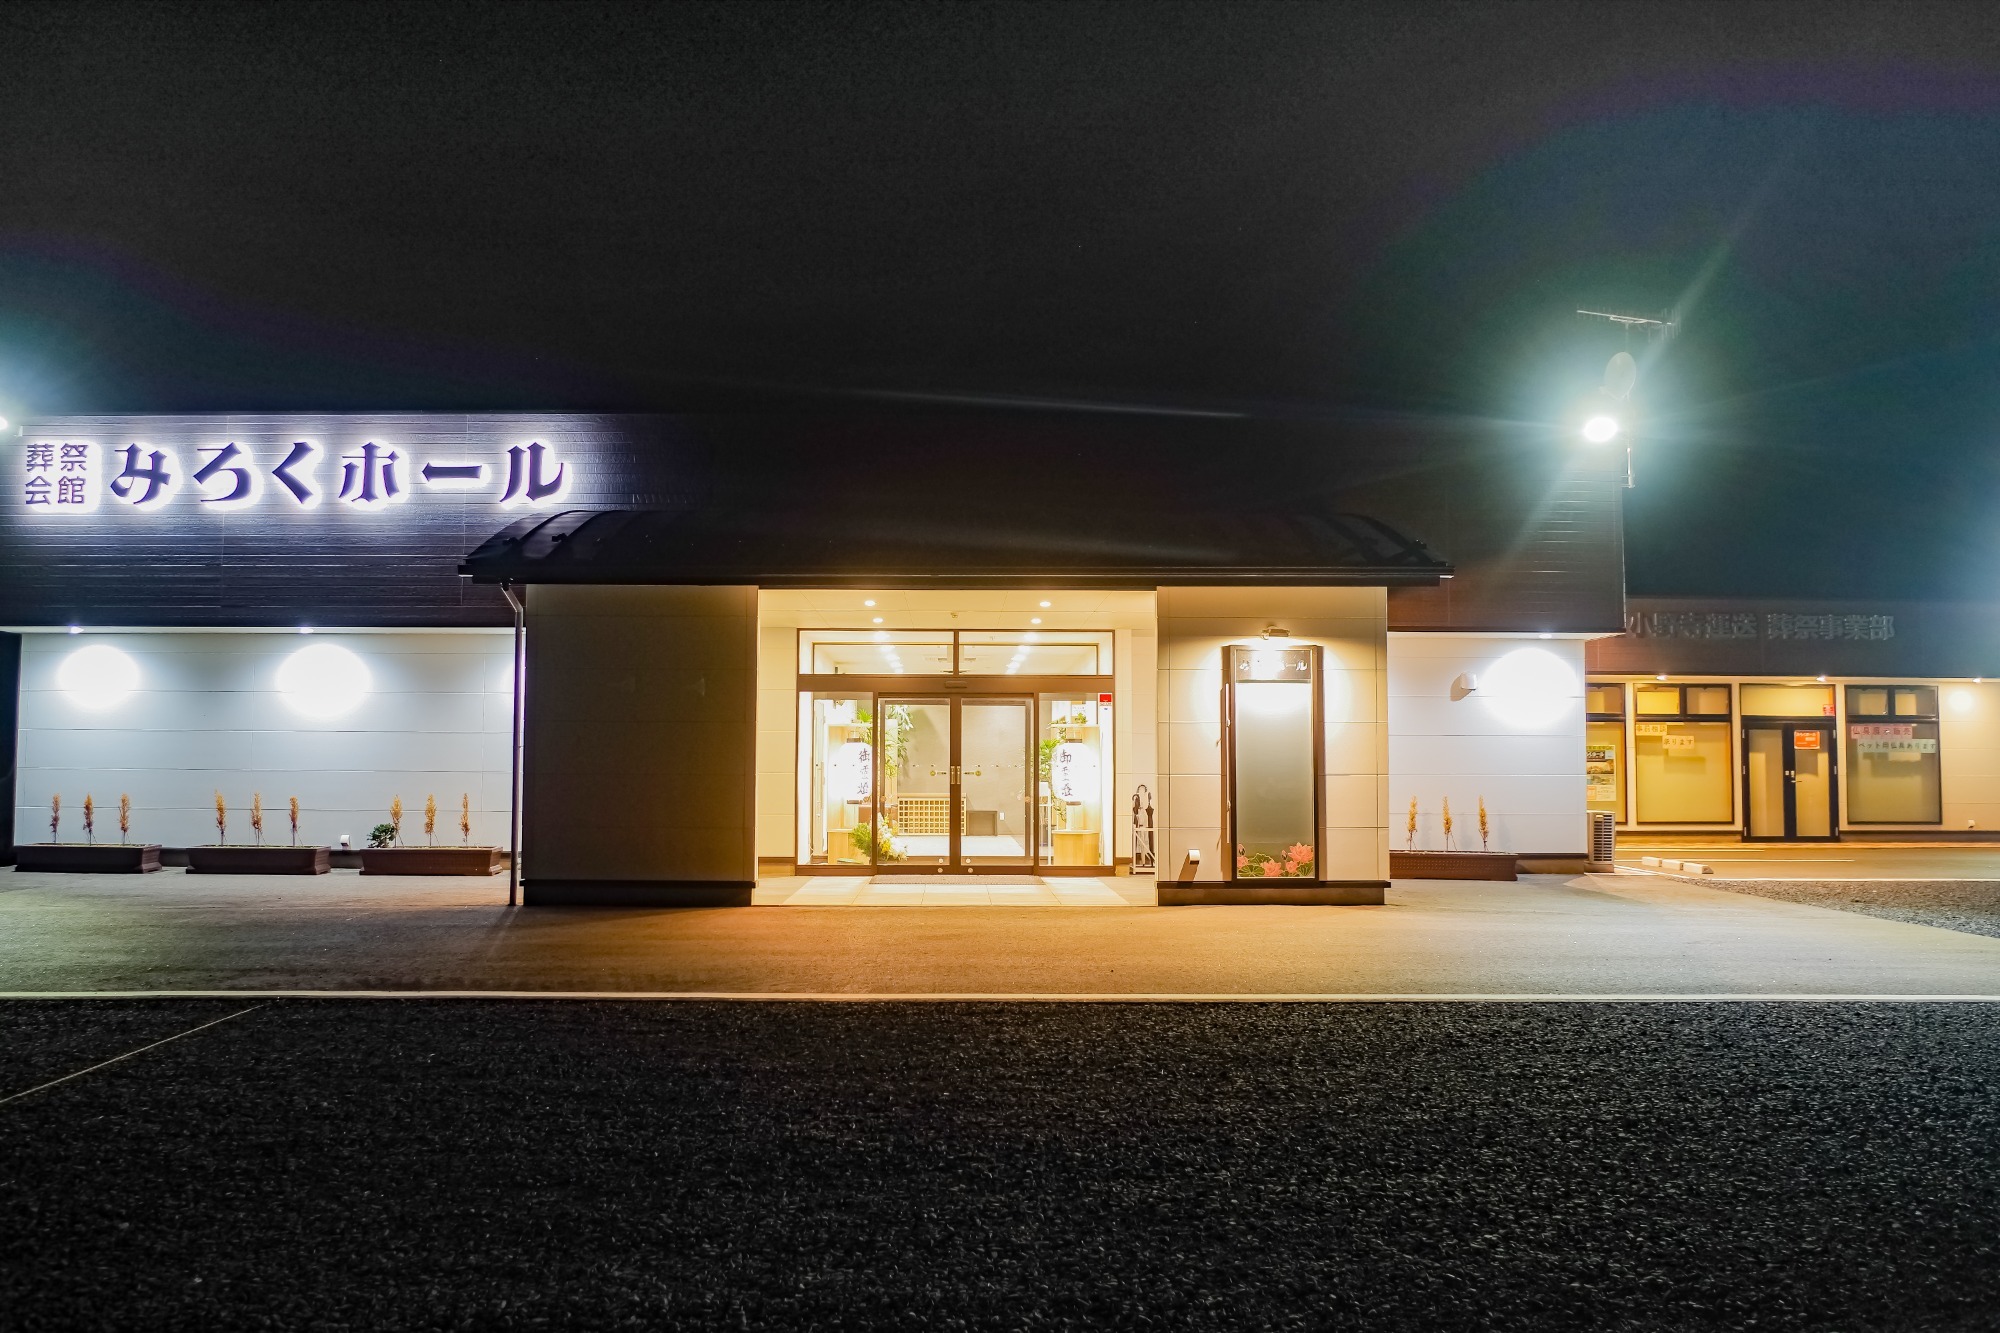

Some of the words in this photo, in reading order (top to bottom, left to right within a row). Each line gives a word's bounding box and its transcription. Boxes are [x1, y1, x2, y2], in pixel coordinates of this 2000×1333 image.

[27, 443, 88, 472] 葬祭
[110, 441, 565, 503] みろくホール
[25, 475, 86, 504] 会館
[1767, 613, 1895, 640] 葬祭事業部
